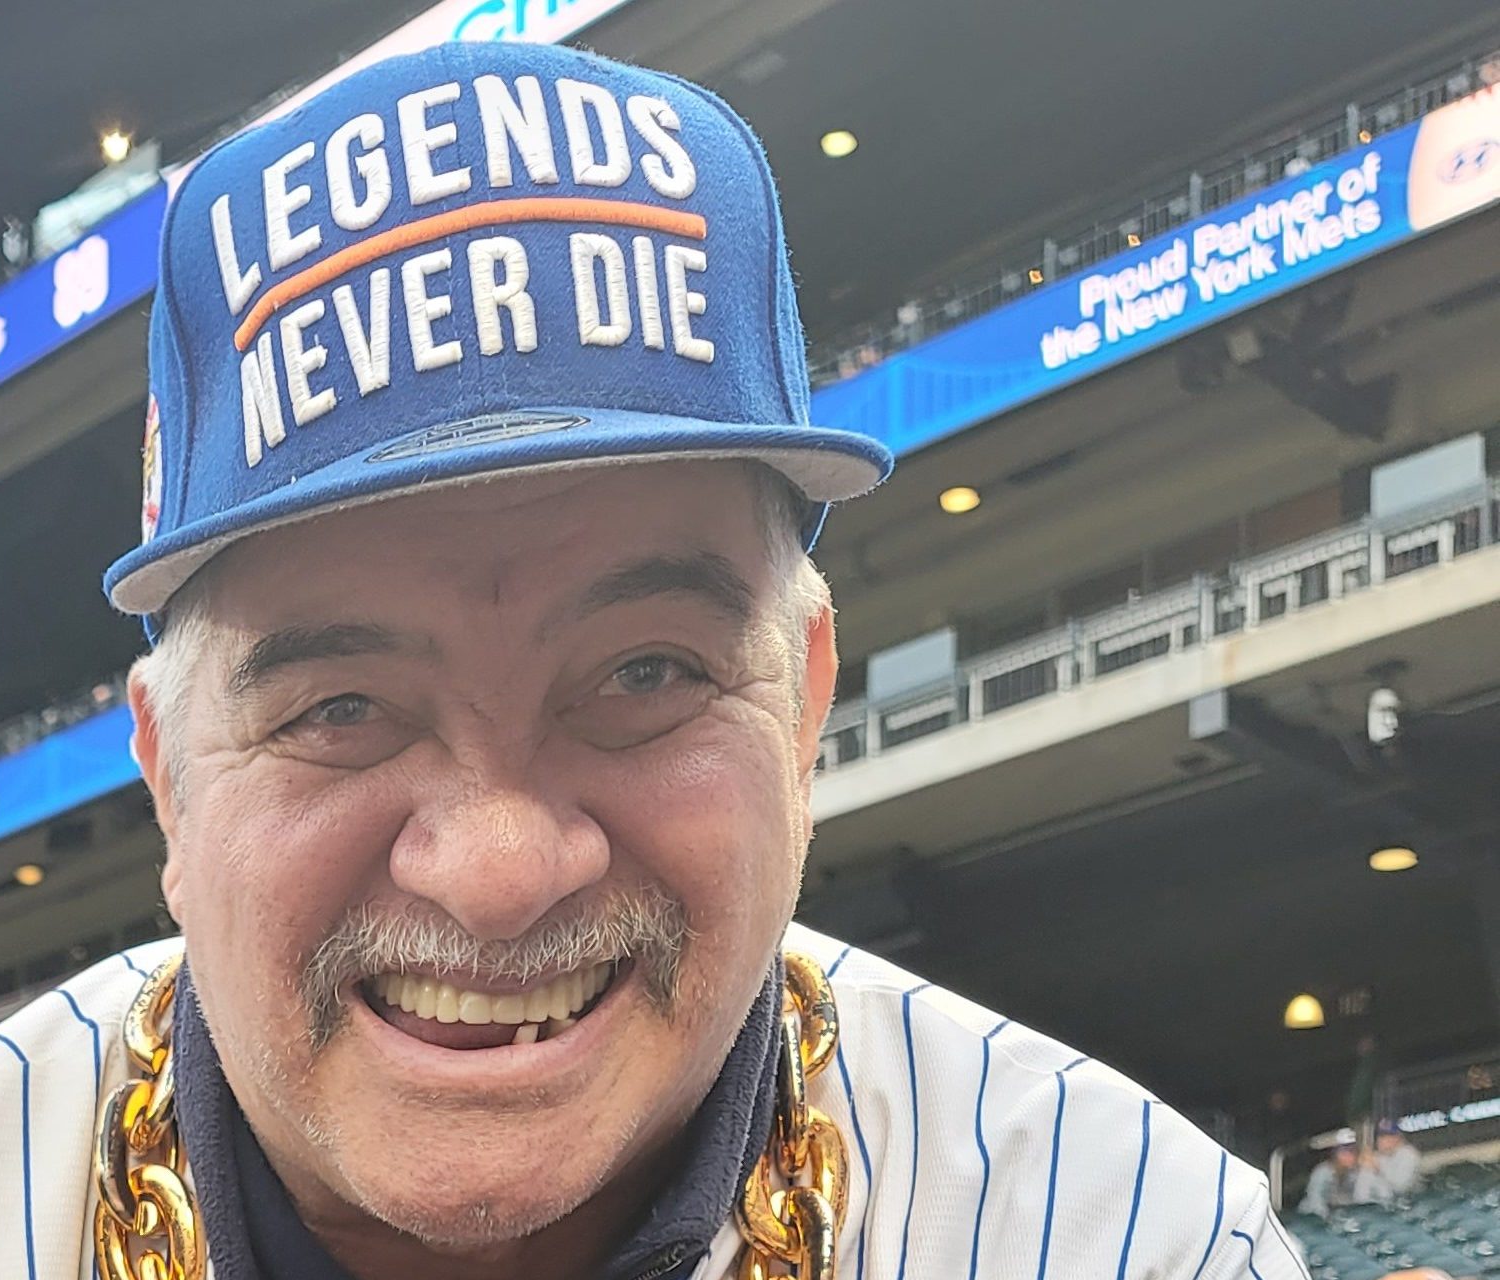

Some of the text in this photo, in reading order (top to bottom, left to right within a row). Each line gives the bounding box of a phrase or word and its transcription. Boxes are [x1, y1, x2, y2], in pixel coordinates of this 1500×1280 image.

[210, 74, 697, 316] LEGENDS
[1039, 199, 1382, 369] the New York Mets
[1079, 151, 1382, 318] Proud Partner of
[240, 235, 539, 469] NEVER
[569, 232, 715, 364] DIE
